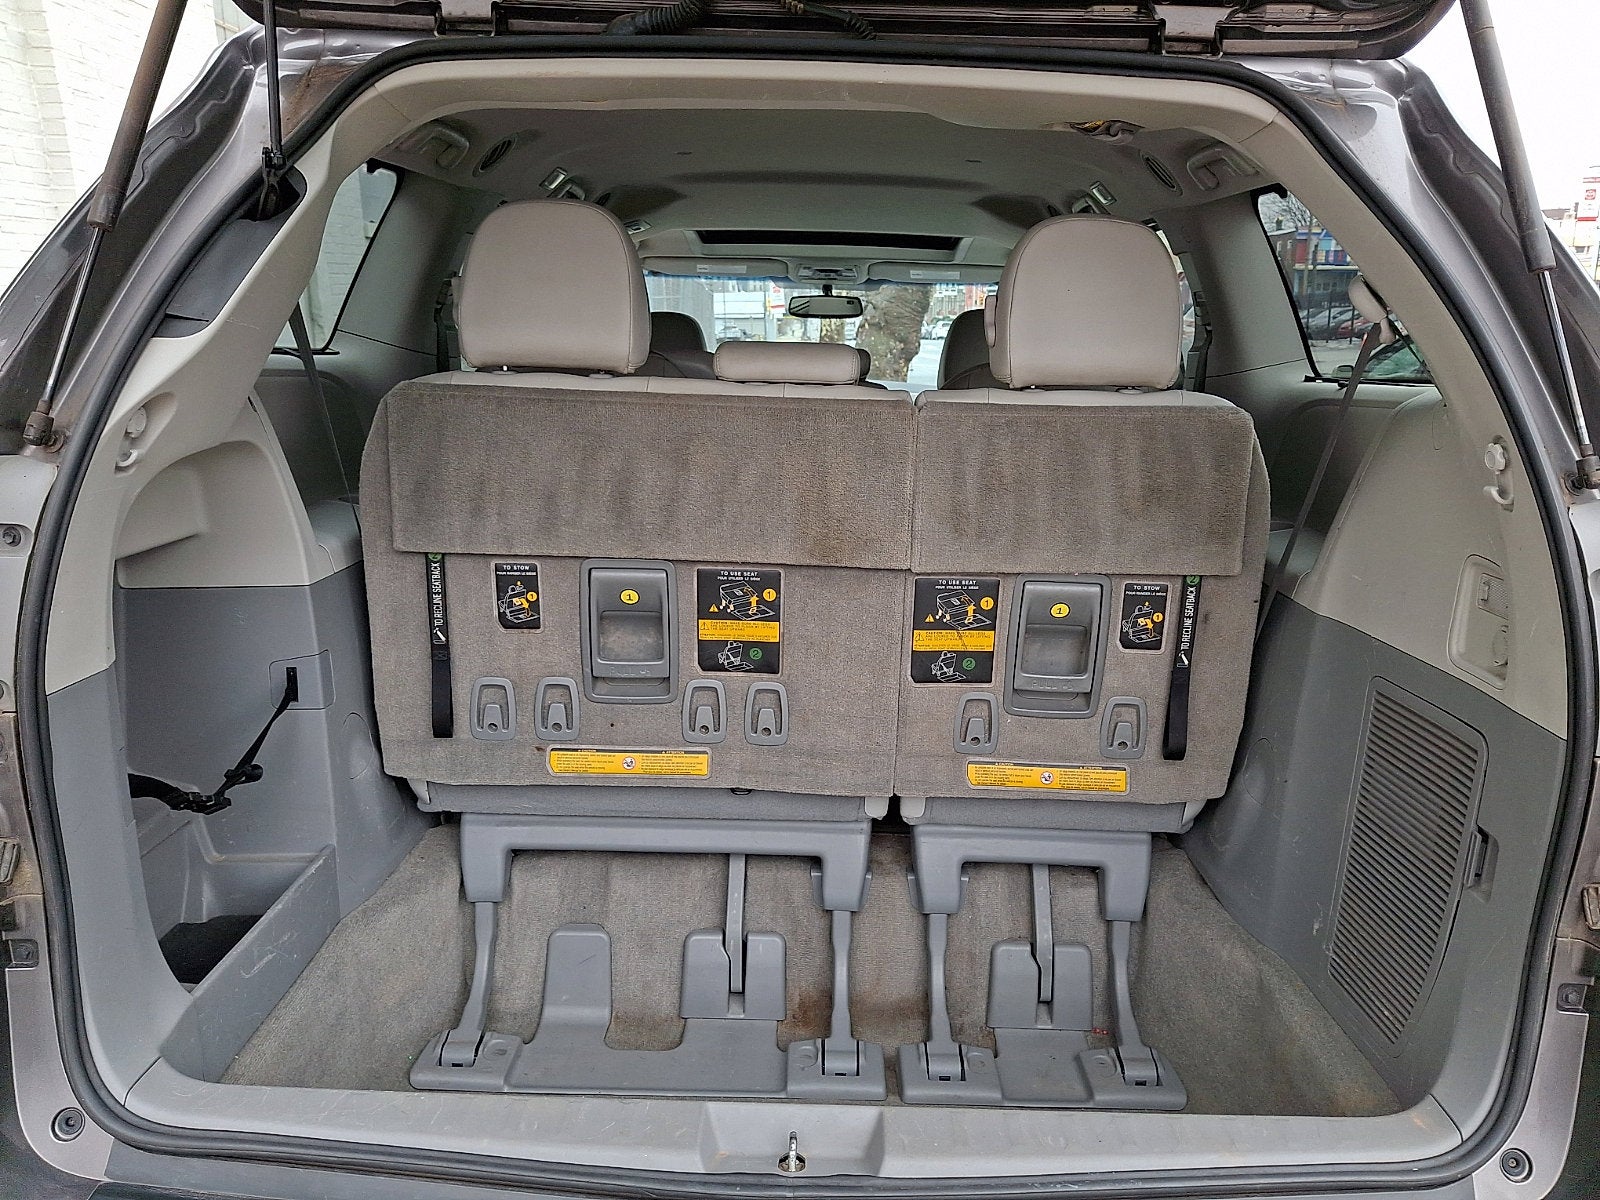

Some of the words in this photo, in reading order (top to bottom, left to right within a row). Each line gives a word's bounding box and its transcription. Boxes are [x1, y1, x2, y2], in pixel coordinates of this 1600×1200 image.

[431, 562, 442, 592] SEATBACK
[433, 593, 442, 618] RECLINE
[1185, 586, 1196, 616] SEATBACK
[1183, 618, 1192, 642] RECLINE
